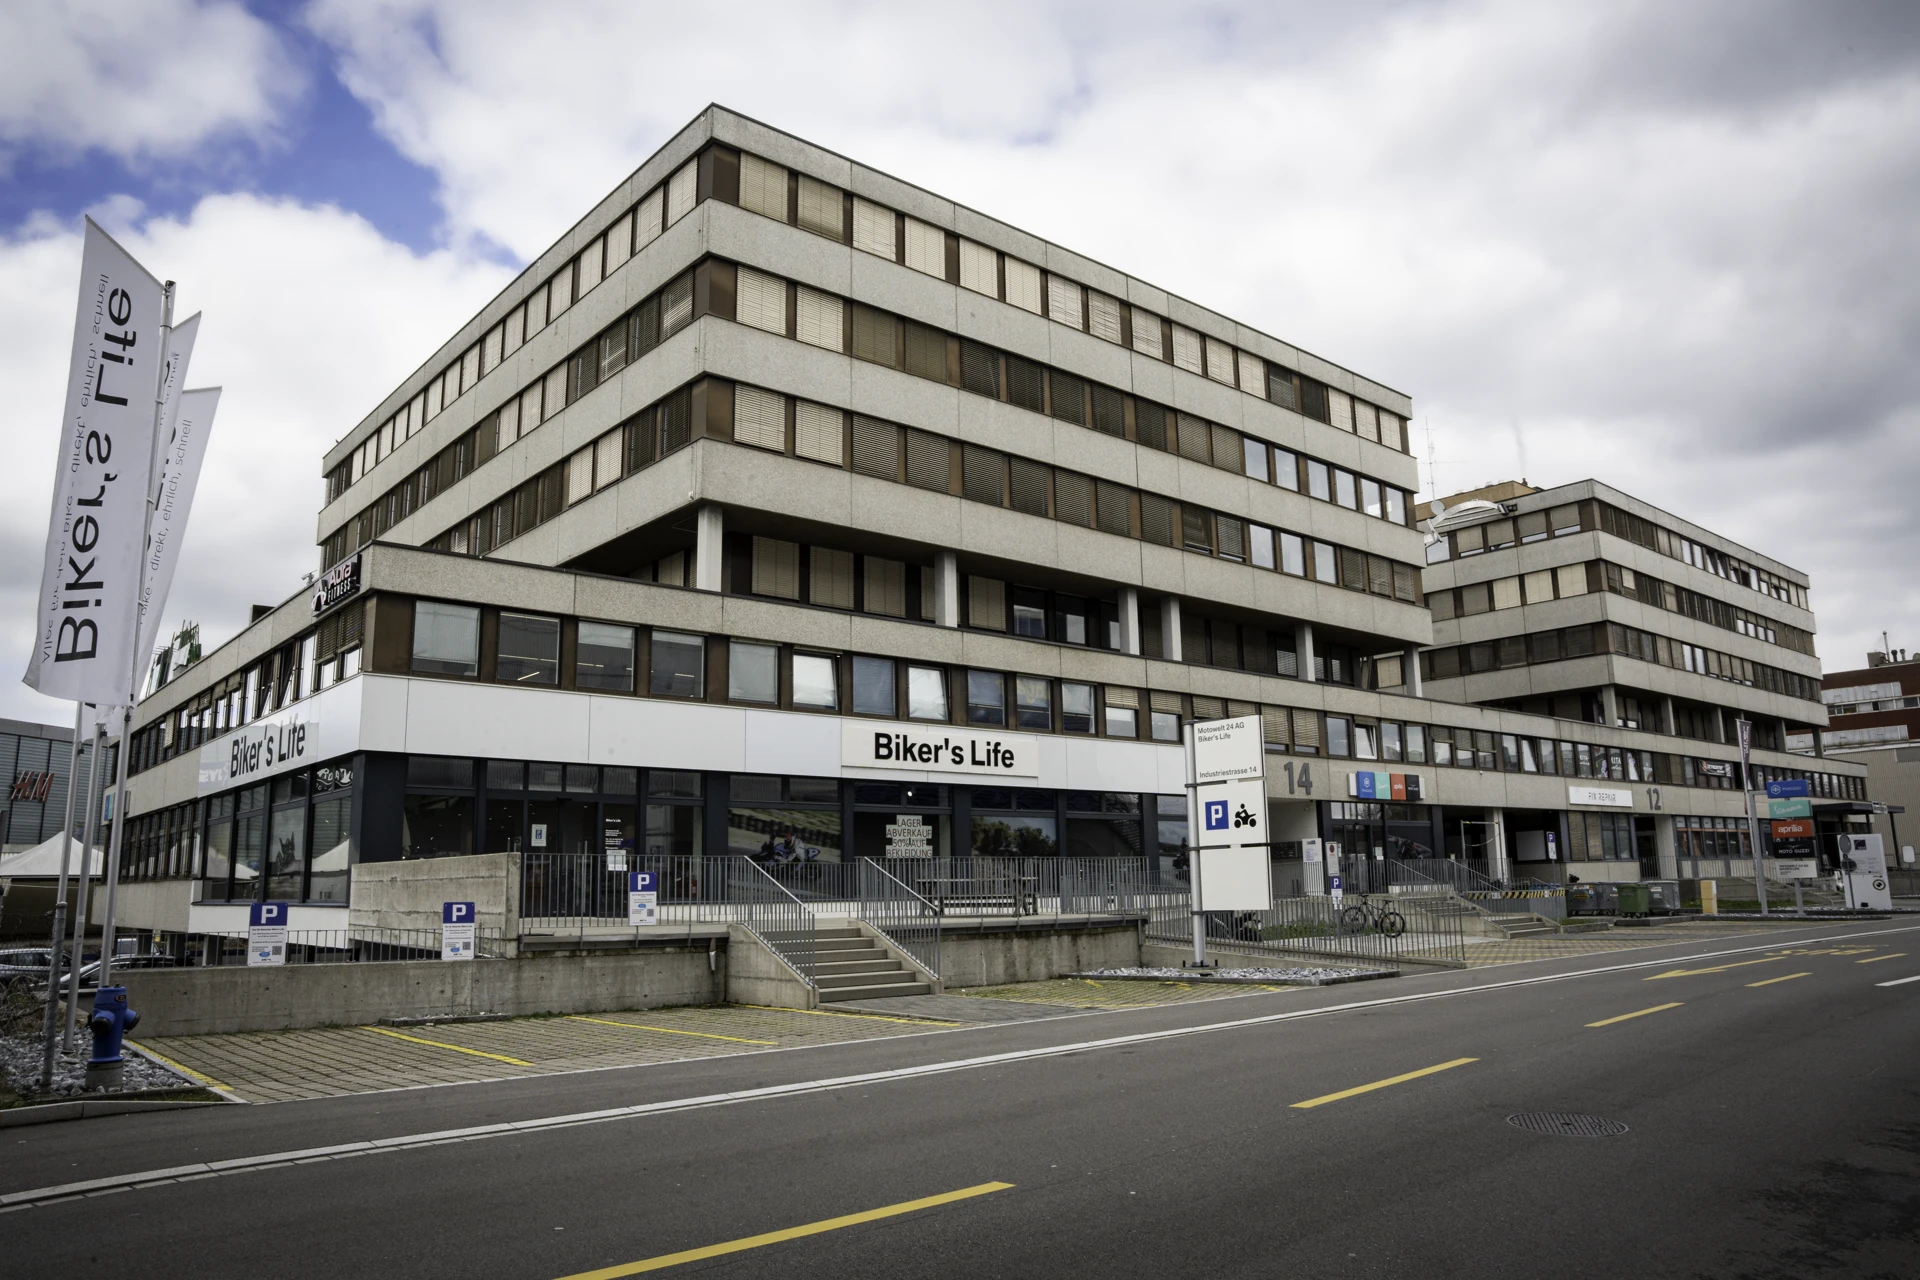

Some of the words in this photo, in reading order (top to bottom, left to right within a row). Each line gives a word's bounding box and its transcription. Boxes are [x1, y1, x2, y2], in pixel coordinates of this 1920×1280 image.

[151, 528, 169, 571] direkt,
[163, 472, 182, 521] ehrlich,
[175, 419, 192, 466] schnell
[1198, 725, 1225, 734] Motowelt
[1226, 723, 1234, 731] 24
[1235, 721, 1245, 729] AG
[230, 724, 274, 778] Biker's
[278, 713, 306, 762] Life
[1198, 734, 1219, 743] Biker's
[874, 732, 965, 765] Biker's
[971, 740, 1015, 768] Life
[1200, 769, 1248, 778] Industriestrasse
[1283, 761, 1313, 795] 14
[10, 770, 55, 804] H&M
[1646, 787, 1662, 811] 12
[897, 818, 921, 827] LAGER
[1211, 804, 1223, 826] P
[887, 828, 931, 838] ABVERKAUF
[1777, 824, 1803, 834] aprilia
[892, 839, 909, 847] 50%
[910, 839, 926, 848] AUF
[886, 849, 932, 858] BEKLEIDUNG
[638, 874, 650, 890] P
[1333, 878, 1339, 888] P
[261, 905, 278, 924] P
[452, 904, 467, 922] P
